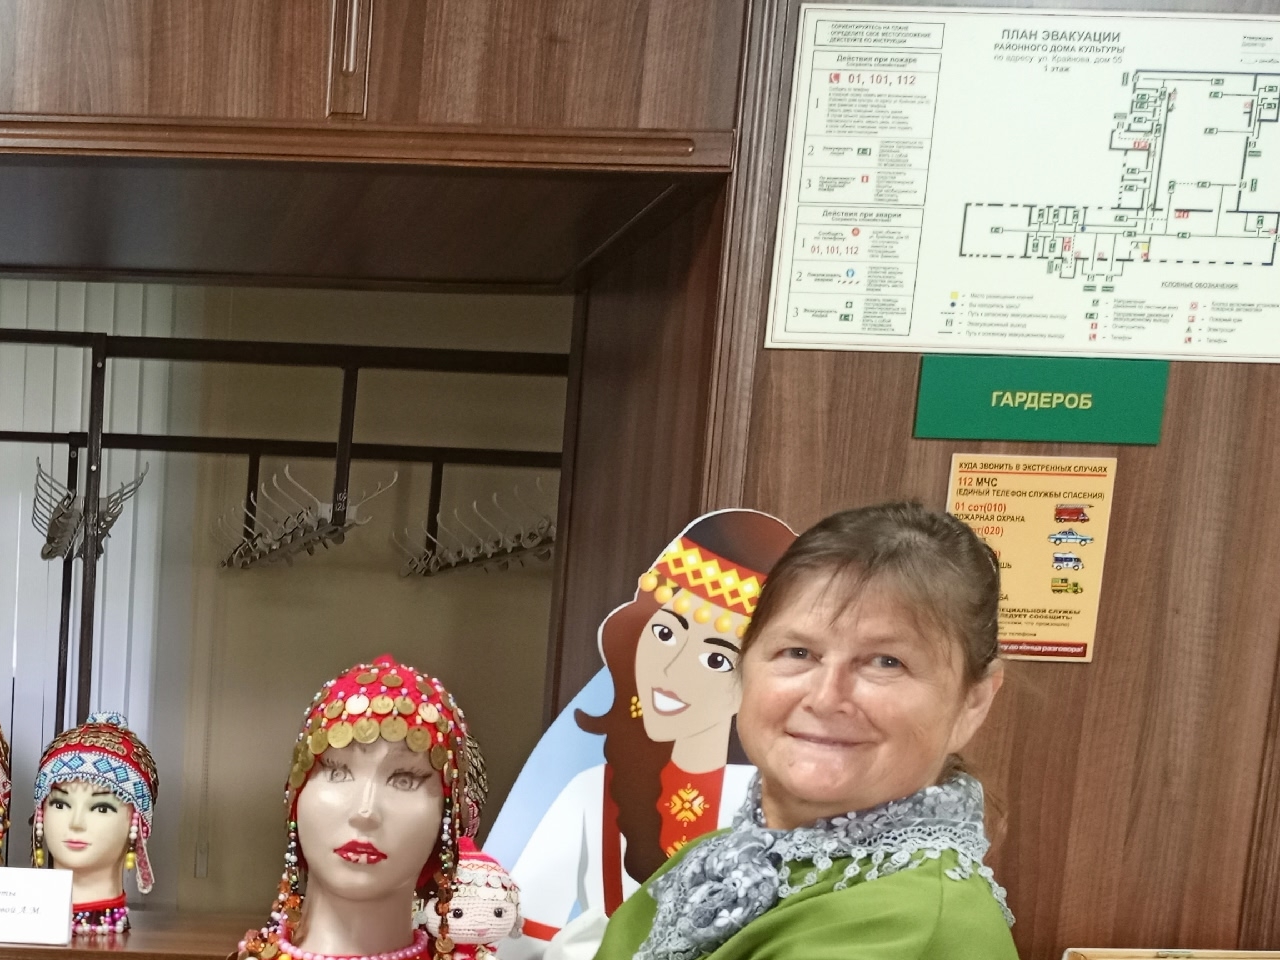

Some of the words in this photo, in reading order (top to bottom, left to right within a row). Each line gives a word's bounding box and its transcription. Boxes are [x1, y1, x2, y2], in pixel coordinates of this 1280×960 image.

[1001, 29, 1038, 41] ПЛАН
[1041, 30, 1122, 44] ЭВАКУАЦИИ
[993, 42, 1048, 52] РАЙОННОГО
[1049, 44, 1076, 53] ДОМА
[1078, 45, 1125, 54] КУЛЬТУРЫ
[836, 55, 873, 63] Действия
[874, 56, 888, 64] при
[848, 73, 865, 86] 01,
[870, 74, 892, 86] 101,
[897, 75, 917, 85] 112
[807, 145, 815, 156] 2
[805, 179, 812, 189] 3
[810, 245, 823, 255] 01,
[826, 245, 842, 256] 101,
[845, 246, 859, 255] 112
[795, 271, 803, 282] 2
[1161, 281, 1193, 289] УСЛОВНЫЕ
[1194, 282, 1239, 290] ОБОЗНАЧЕНИЯ
[792, 307, 799, 318] 3
[991, 391, 1093, 411] ГАРДЕРОБ
[959, 462, 978, 471] КУДА
[980, 463, 1013, 471] ЗВОНИТЬ
[1022, 464, 1071, 472] ЭКСТРЕННЫХ
[1073, 465, 1108, 473] СЛУЧАЯХ
[958, 478, 973, 487] 112
[975, 478, 998, 487] МЧС
[956, 487, 990, 497] (ЕДИНЫЙ
[992, 489, 1026, 498] ТЕЛЕФОН
[1028, 490, 1061, 498] СЛУЖБЫ
[1063, 491, 1105, 501] СПАСЕНИЯ)
[955, 502, 965, 511] 01
[968, 503, 1006, 513] сот(010)
